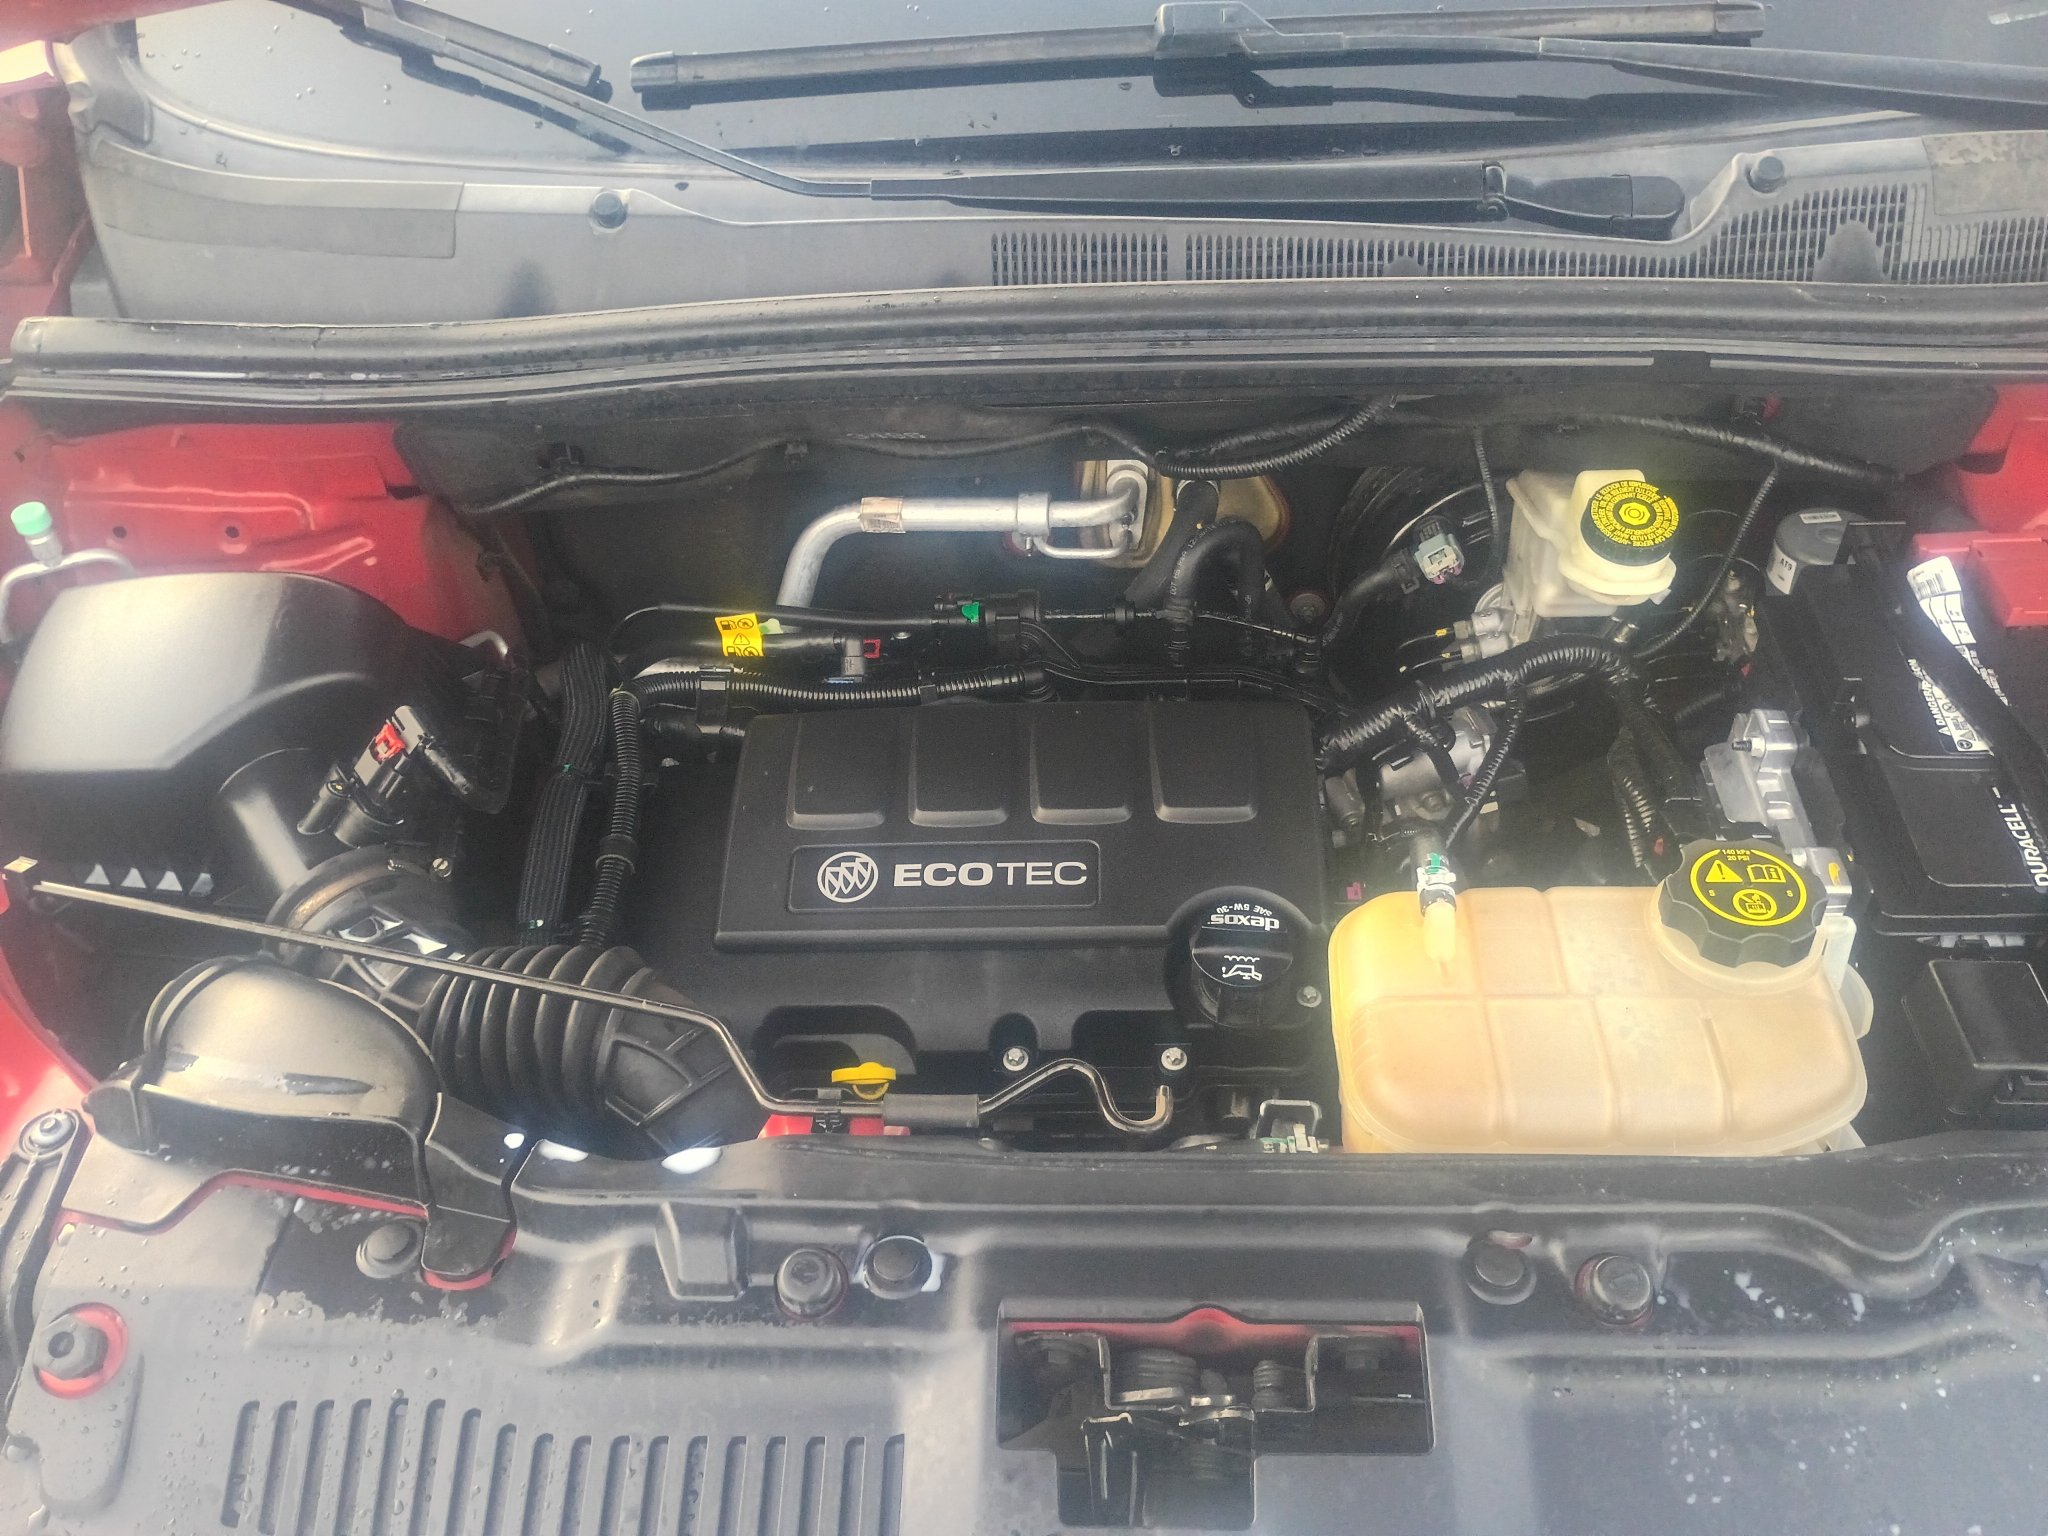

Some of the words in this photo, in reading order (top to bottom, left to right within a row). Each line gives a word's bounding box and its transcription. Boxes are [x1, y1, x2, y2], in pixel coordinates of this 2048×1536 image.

[893, 861, 1087, 887] ECOTEC
[1216, 903, 1250, 914] 5W-30
[1253, 904, 1272, 916] SAE
[1210, 914, 1279, 931] dexos
